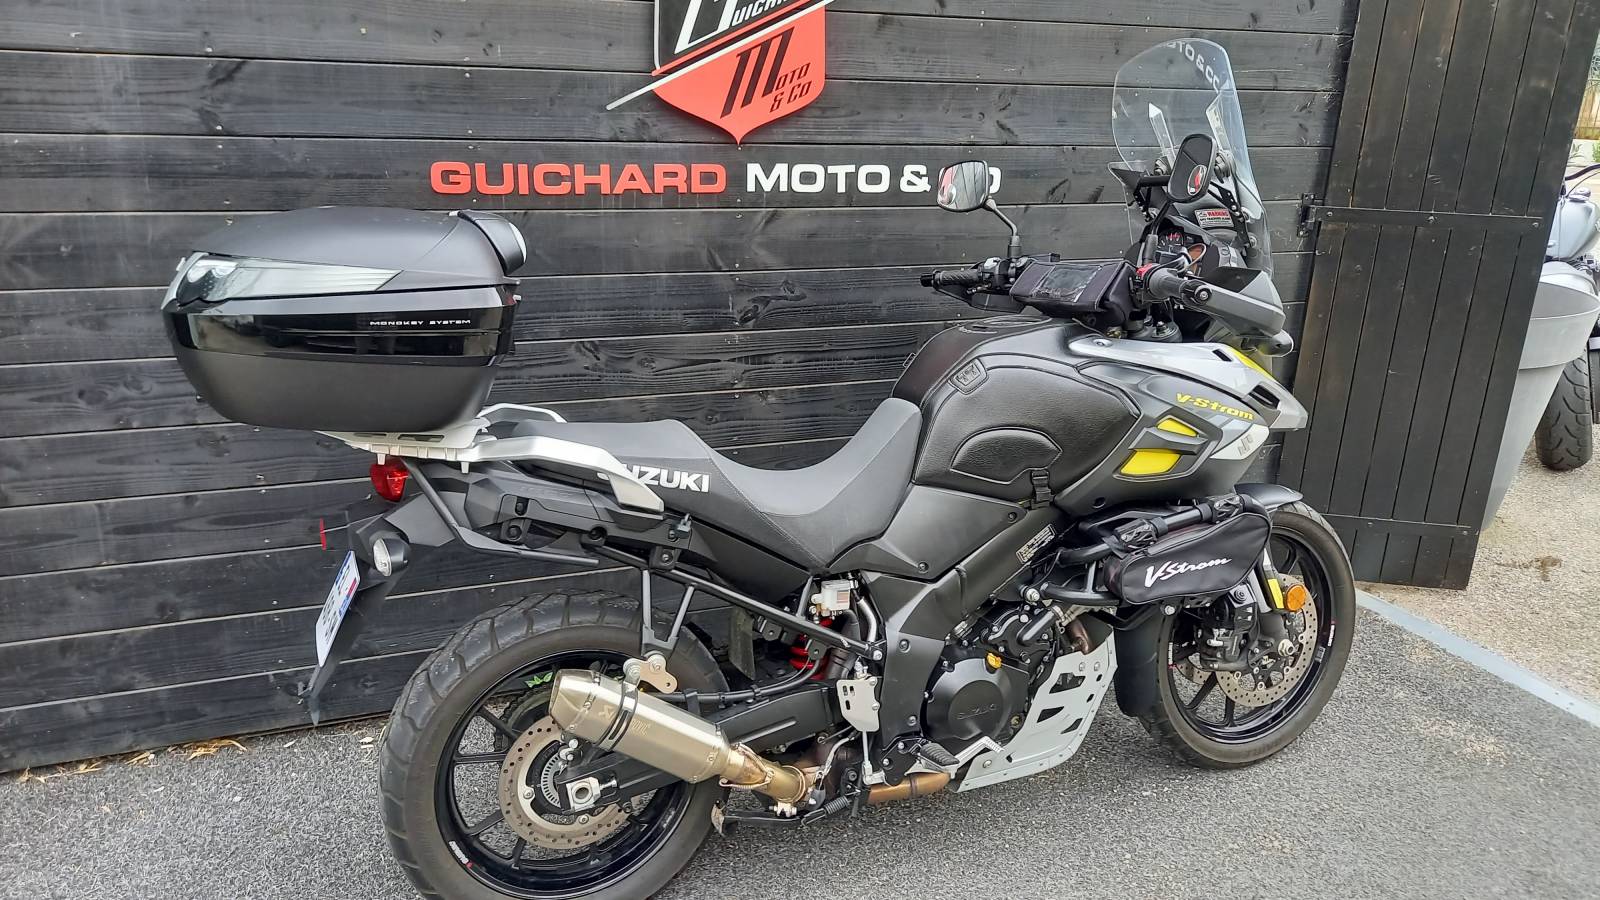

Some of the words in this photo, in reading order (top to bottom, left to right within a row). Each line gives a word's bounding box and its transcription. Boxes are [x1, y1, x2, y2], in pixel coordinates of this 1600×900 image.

[720, 27, 811, 119] MOTO
[769, 91, 785, 113] &
[786, 81, 812, 105] CO
[430, 161, 727, 195] GUICHARD
[746, 163, 891, 194] MOTO
[899, 164, 932, 193] &
[1176, 392, 1254, 420] V-Strom
